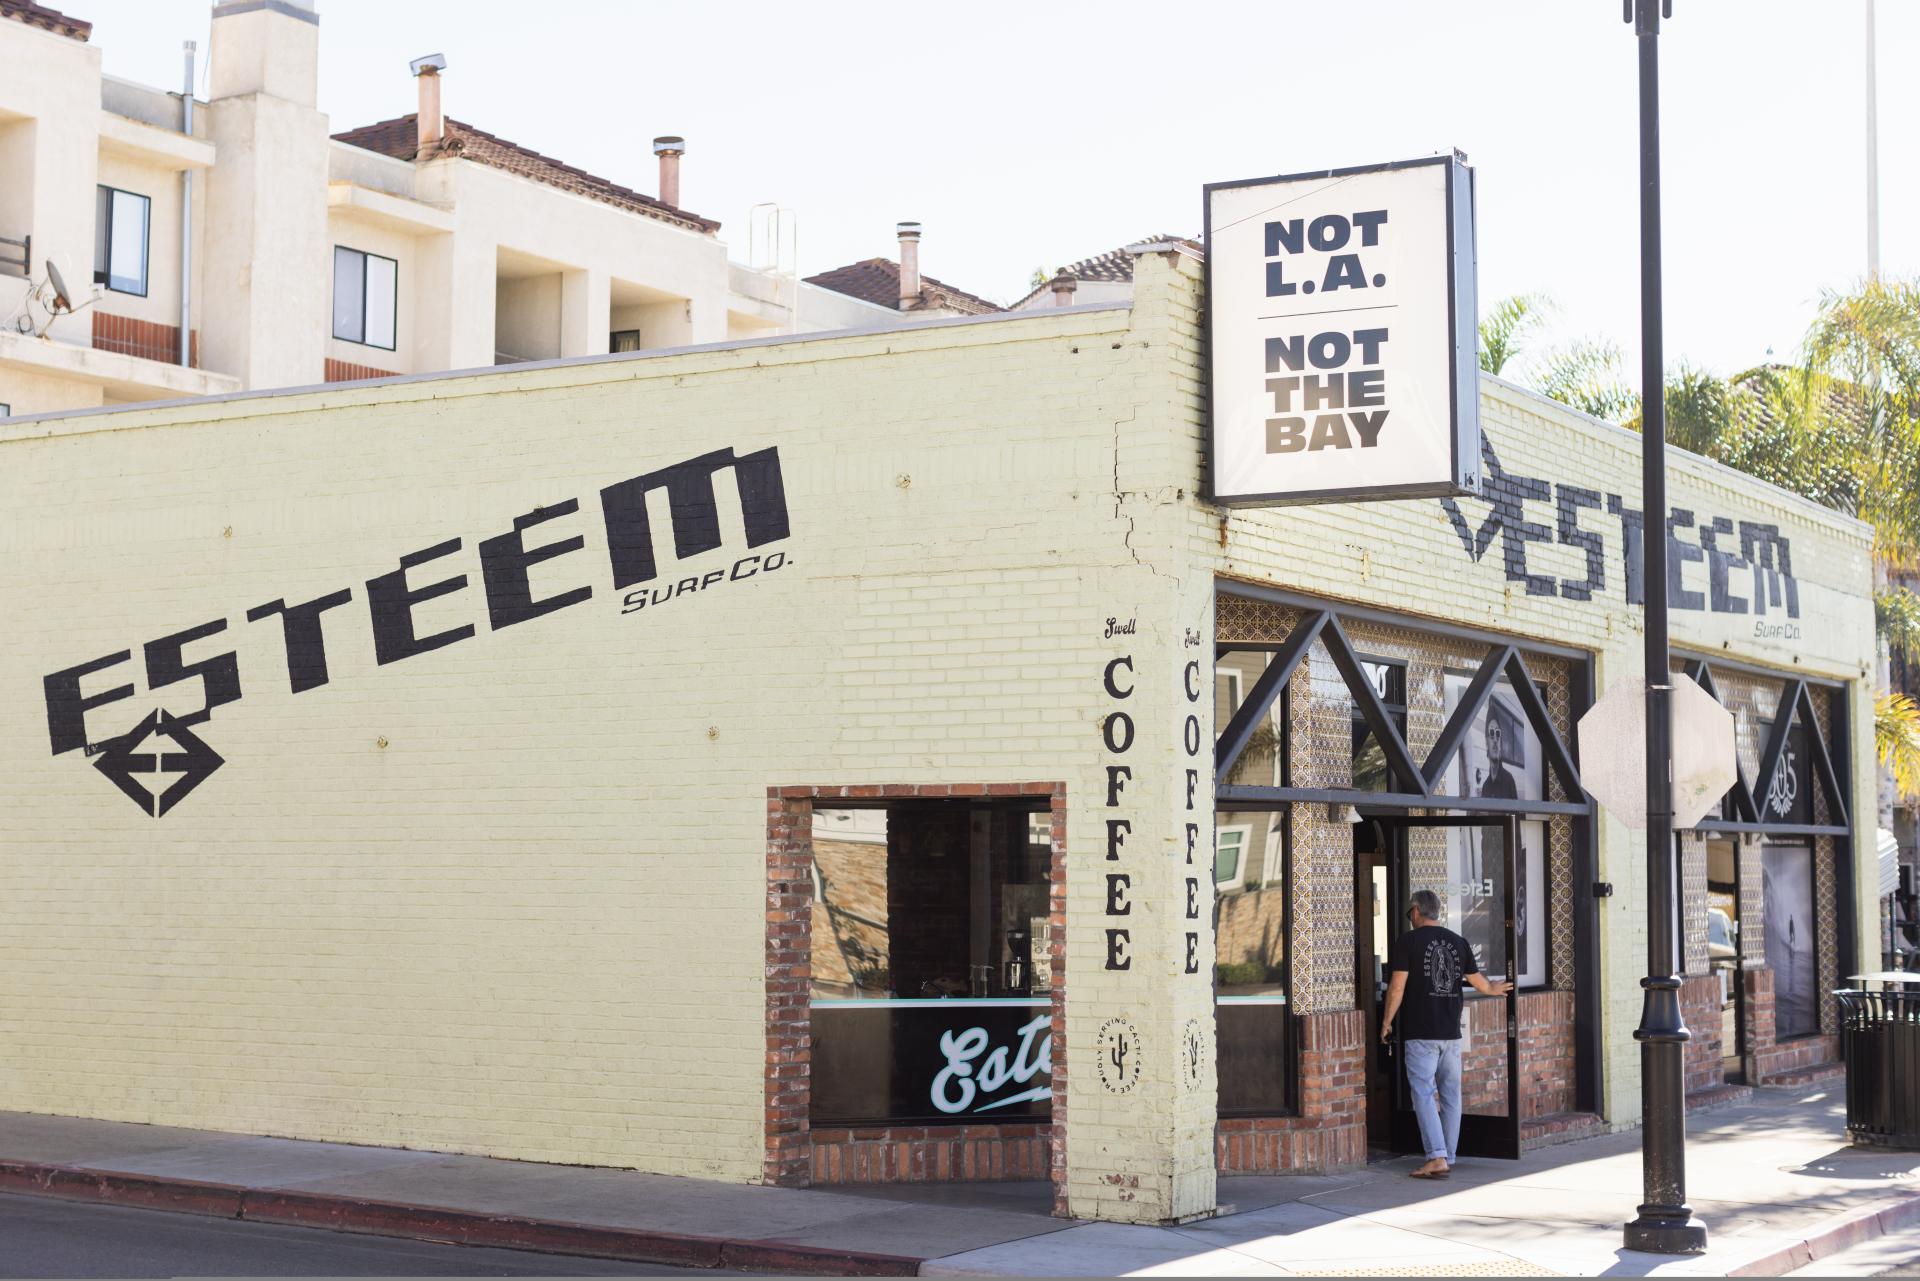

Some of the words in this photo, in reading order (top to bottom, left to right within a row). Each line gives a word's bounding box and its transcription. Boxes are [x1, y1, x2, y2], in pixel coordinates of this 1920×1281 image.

[1265, 210, 1388, 257] NOT
[1265, 254, 1387, 298] L.A.
[1265, 328, 1389, 373] NOT
[1265, 370, 1385, 413] THE
[1265, 410, 1390, 454] BAY
[43, 446, 791, 756] ESTEEM
[1104, 617, 1137, 640] Swell
[1103, 655, 1135, 970] COFFEE
[1184, 659, 1200, 974] COFFEE
[1097, 1017, 1127, 1045] SERVING
[1128, 1025, 1141, 1056] CACTI
[1119, 1060, 1141, 1094] COFFEE
